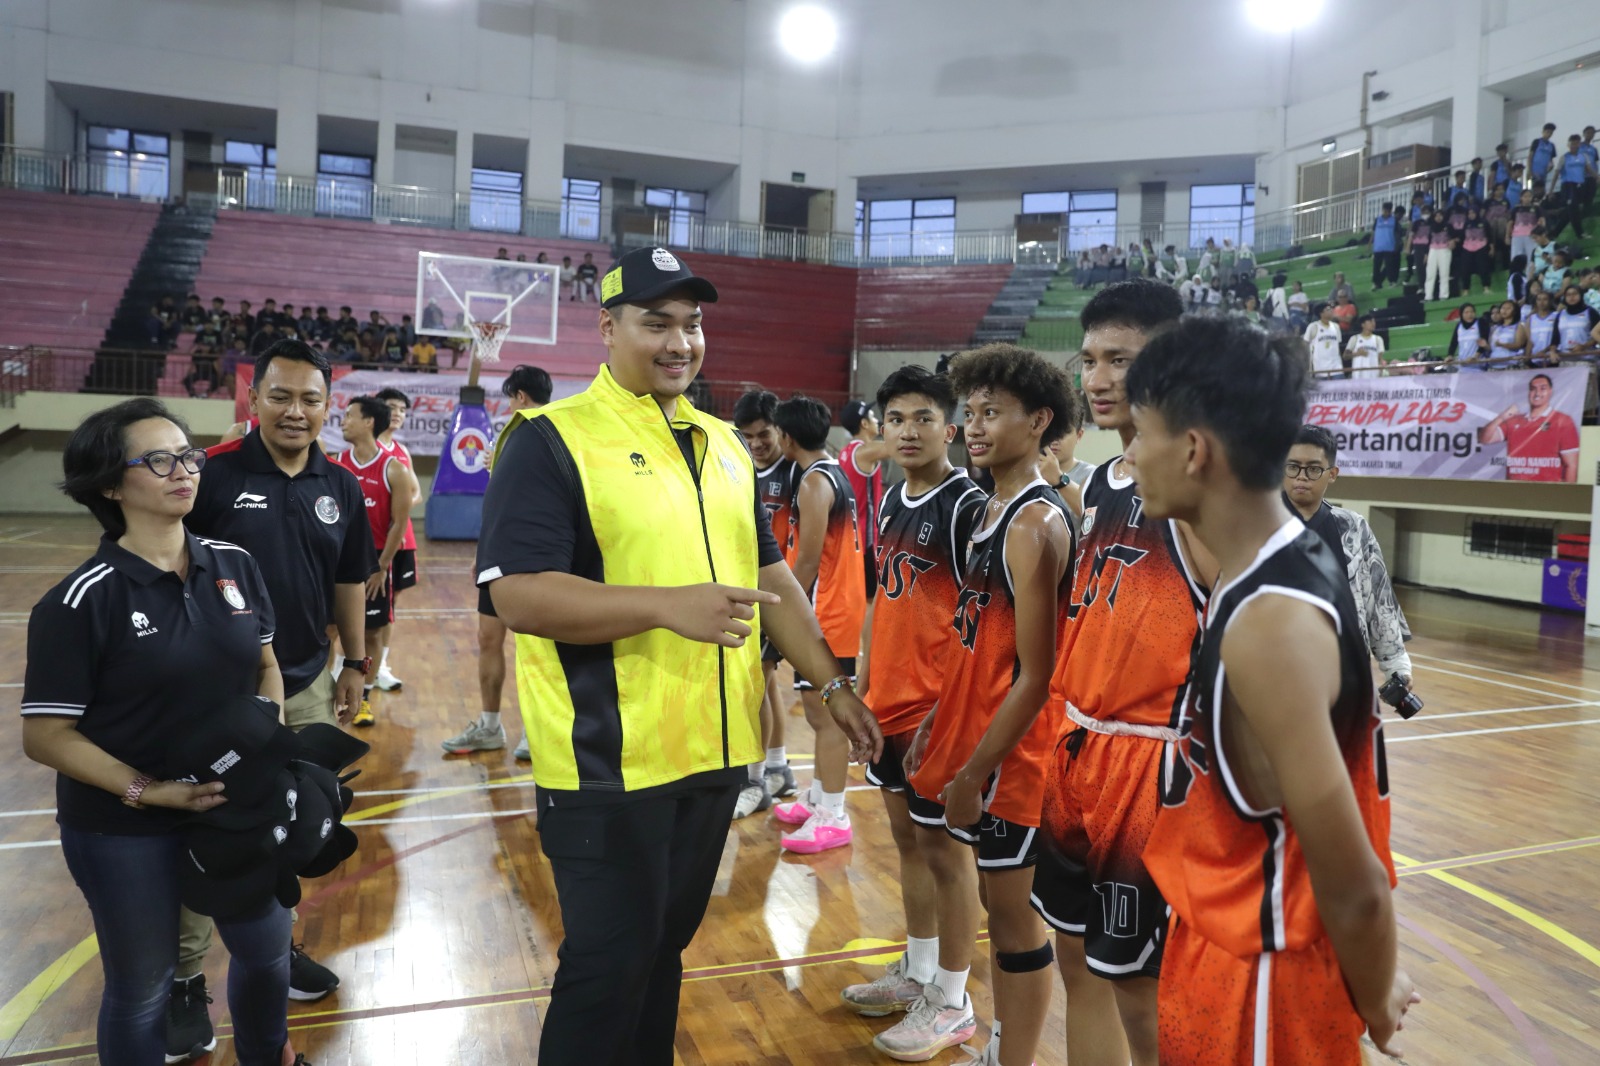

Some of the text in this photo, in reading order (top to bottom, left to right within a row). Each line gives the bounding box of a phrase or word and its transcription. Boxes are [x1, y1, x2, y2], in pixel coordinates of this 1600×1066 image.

[1350, 391, 1365, 401] SMA
[1373, 389, 1389, 400] SMK
[1391, 388, 1424, 400] JAKARTA
[1426, 387, 1452, 399] TIMUR
[1306, 400, 1467, 427] PEMUDA 2023
[1335, 427, 1482, 457] ertanding!
[769, 481, 782, 496] 12
[136, 626, 159, 638] MILLS
[210, 749, 237, 771] GOTONG
[1092, 881, 1139, 938] 10
